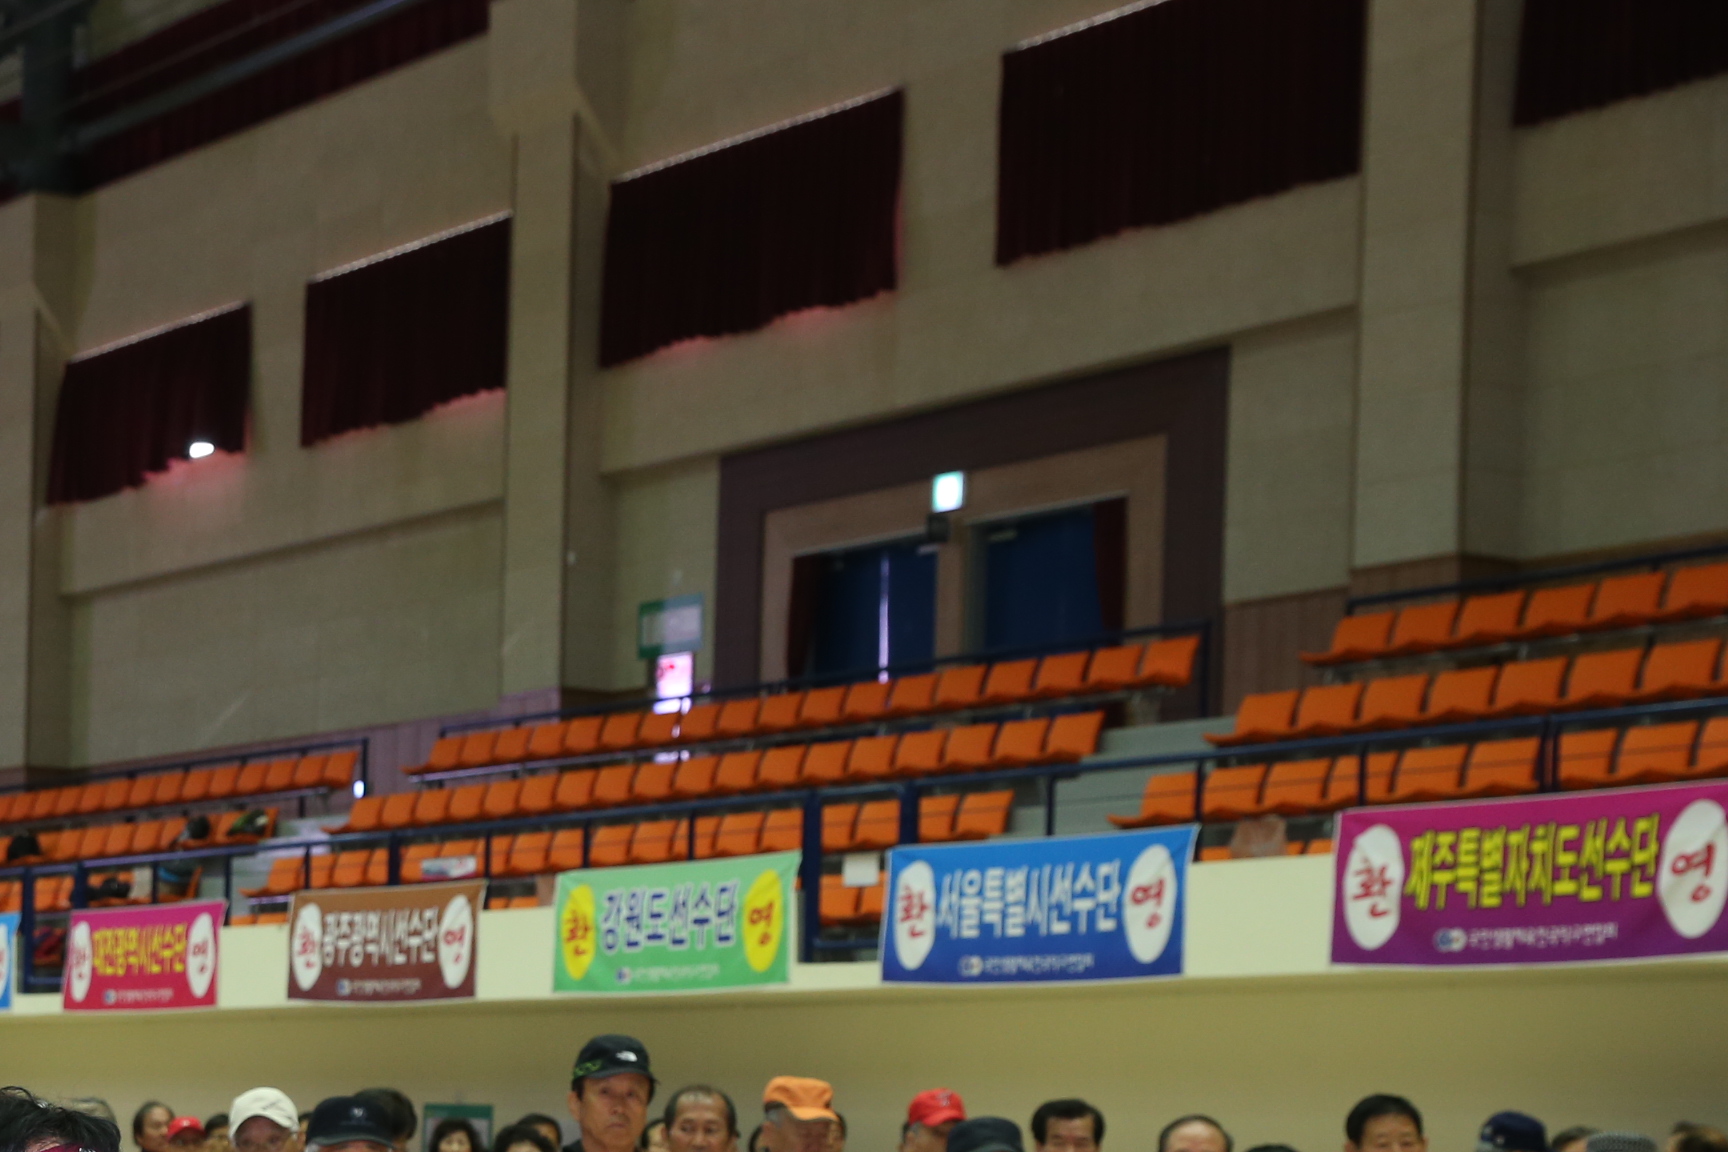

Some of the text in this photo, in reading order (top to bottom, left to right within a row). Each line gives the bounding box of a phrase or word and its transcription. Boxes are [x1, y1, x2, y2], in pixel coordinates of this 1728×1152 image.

[936, 858, 1122, 939] 서울특별시선수단
[1130, 877, 1166, 930] 영
[1352, 811, 1716, 918] 환 제주특별자치도선수단 영
[322, 905, 440, 968] 광주광역시선수단
[601, 874, 741, 956] 강원도선수단
